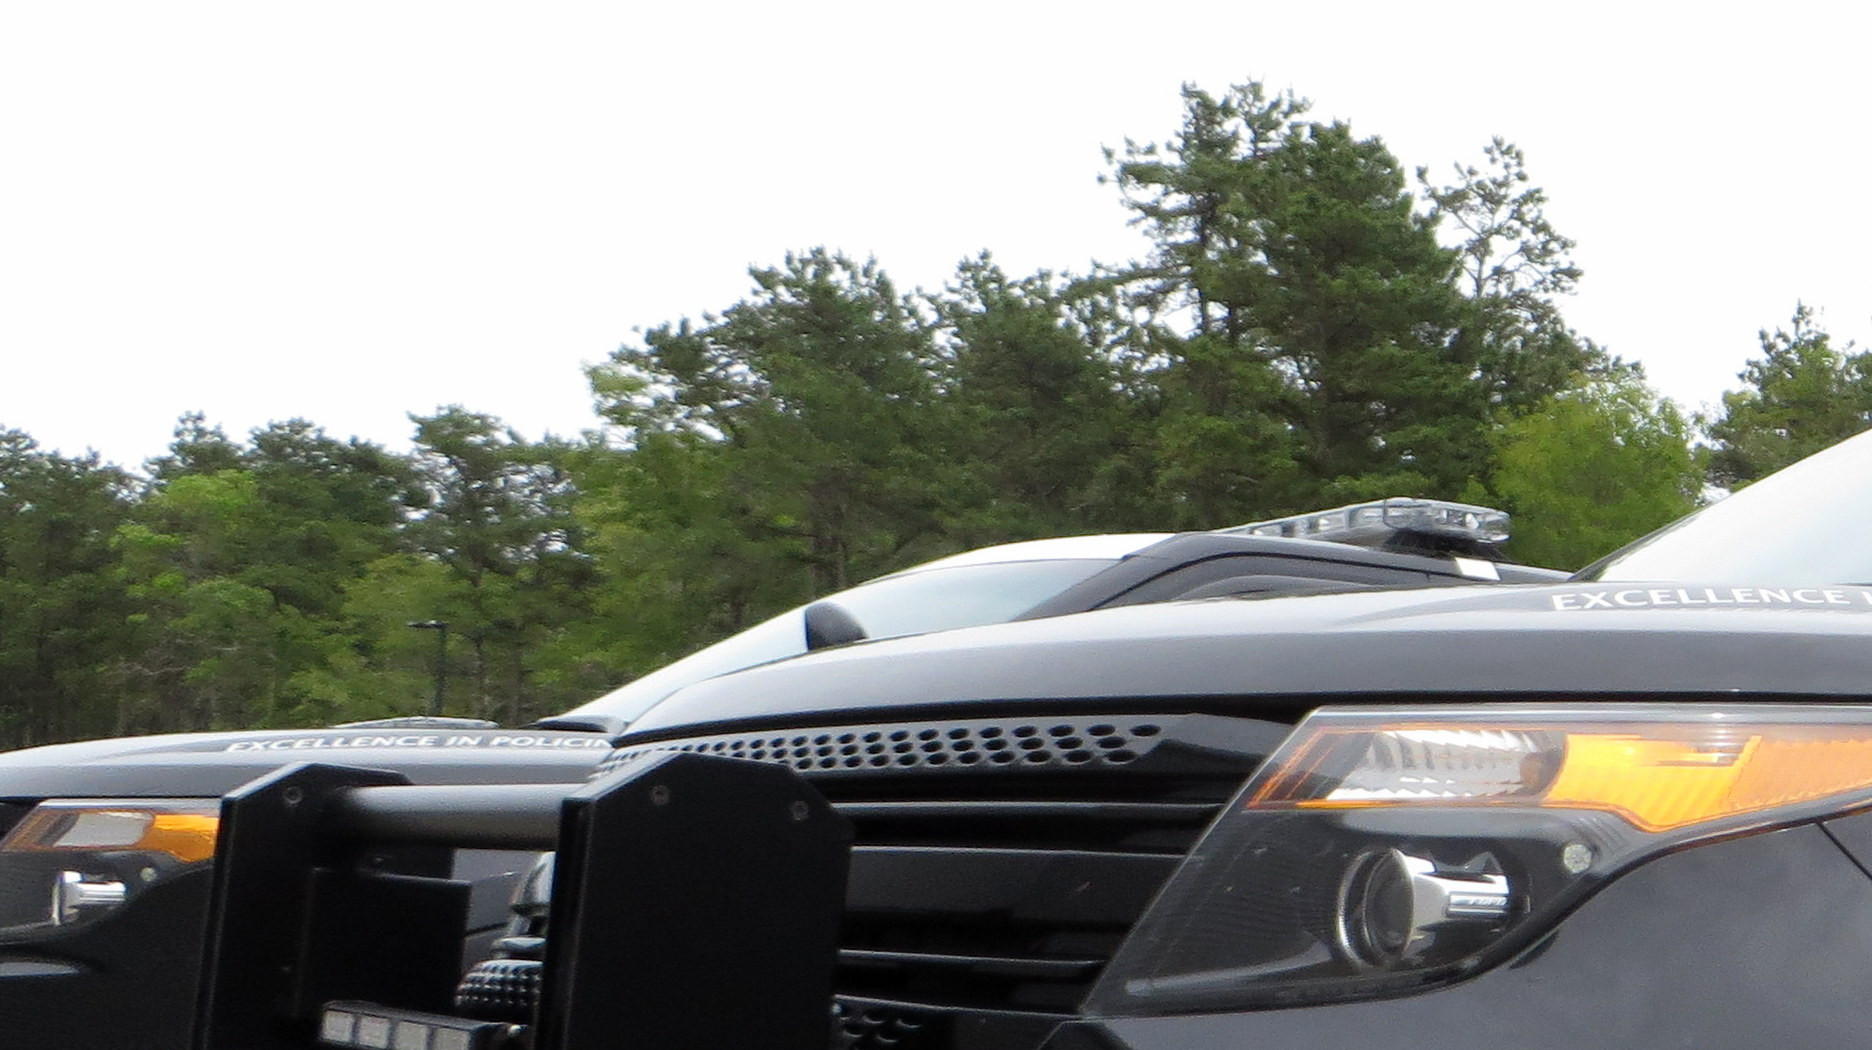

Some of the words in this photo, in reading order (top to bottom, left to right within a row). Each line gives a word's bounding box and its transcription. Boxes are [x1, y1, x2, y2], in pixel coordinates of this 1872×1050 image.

[1551, 588, 1851, 611] EXCELLENCE
[226, 736, 439, 752] EXCELLENCE
[446, 735, 483, 746] IN
[490, 736, 611, 748] POLICIN
